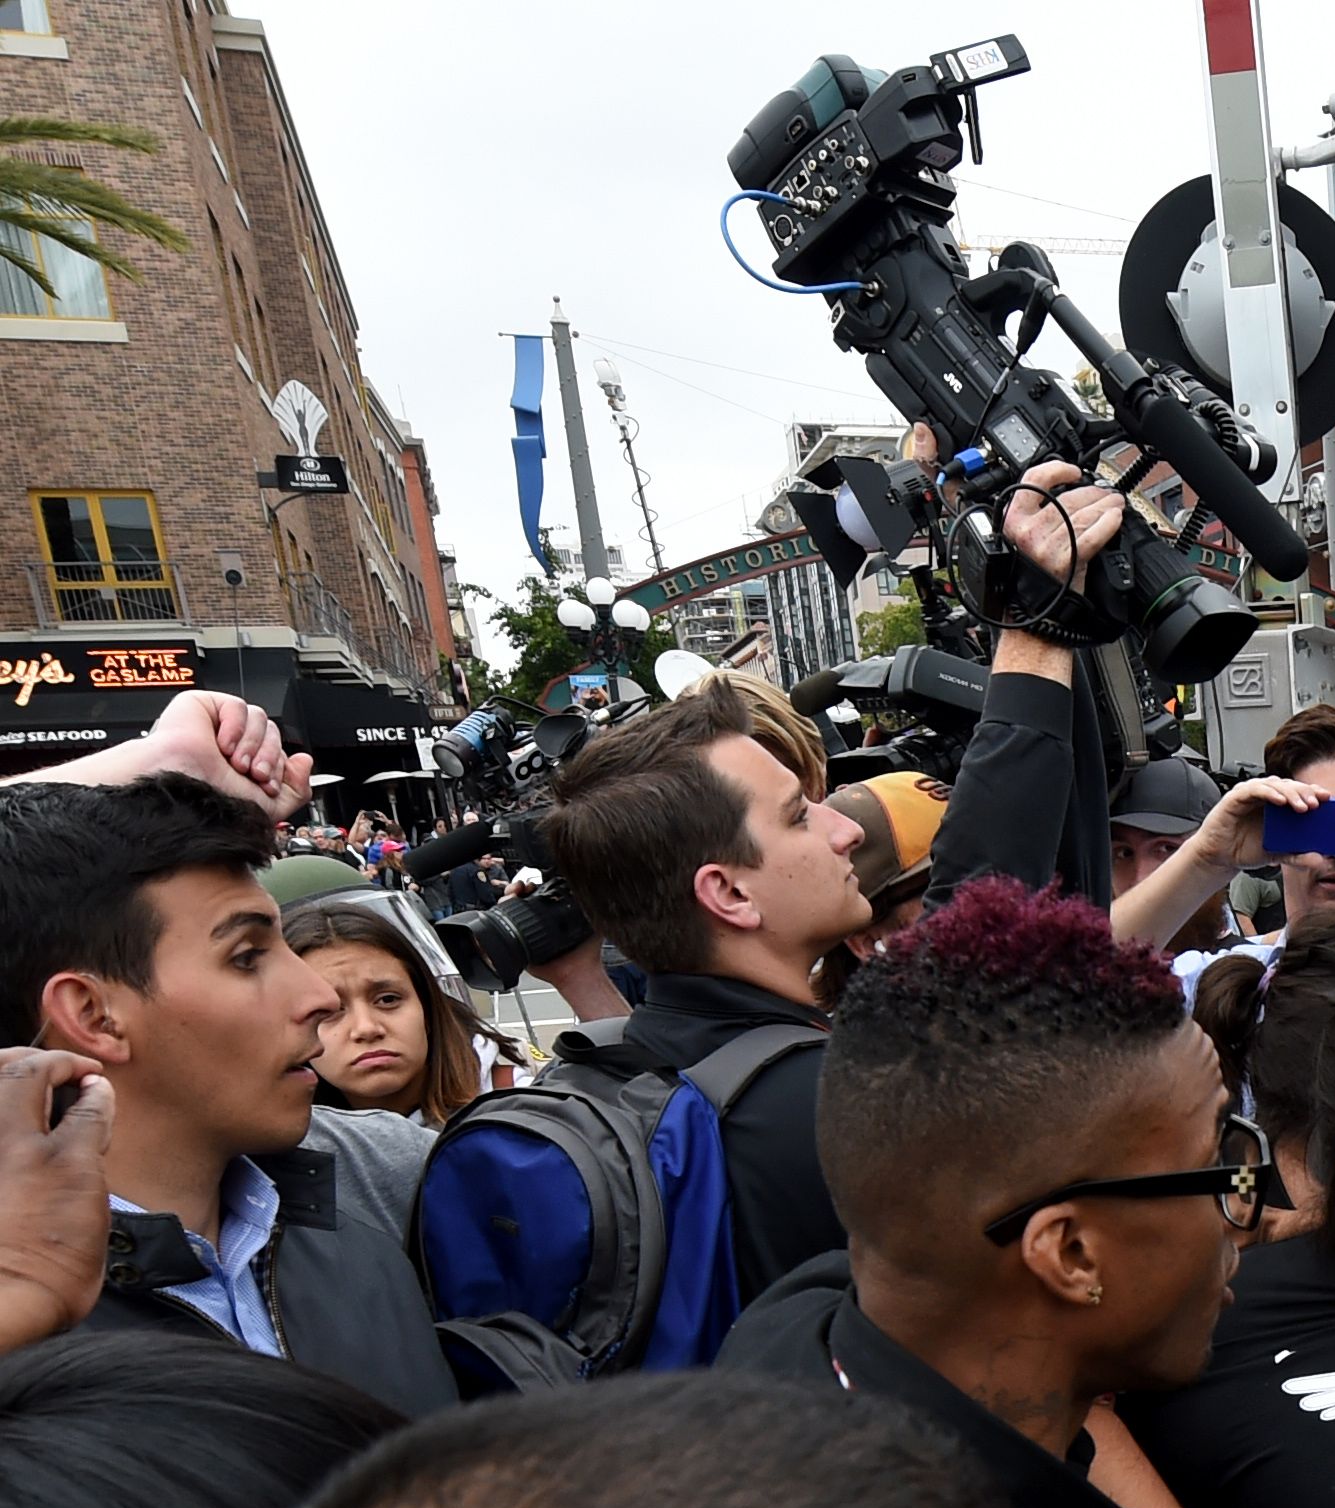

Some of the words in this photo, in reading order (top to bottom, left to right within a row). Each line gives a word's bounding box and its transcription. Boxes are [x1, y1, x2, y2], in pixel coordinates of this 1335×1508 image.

[942, 371, 964, 394] JVC
[294, 470, 332, 482] Hilton
[104, 655, 129, 669] AT
[134, 653, 178, 668] THE
[90, 667, 194, 683] GASLAMP
[27, 729, 108, 742] SEAFOOD
[356, 727, 408, 742] SINCE
